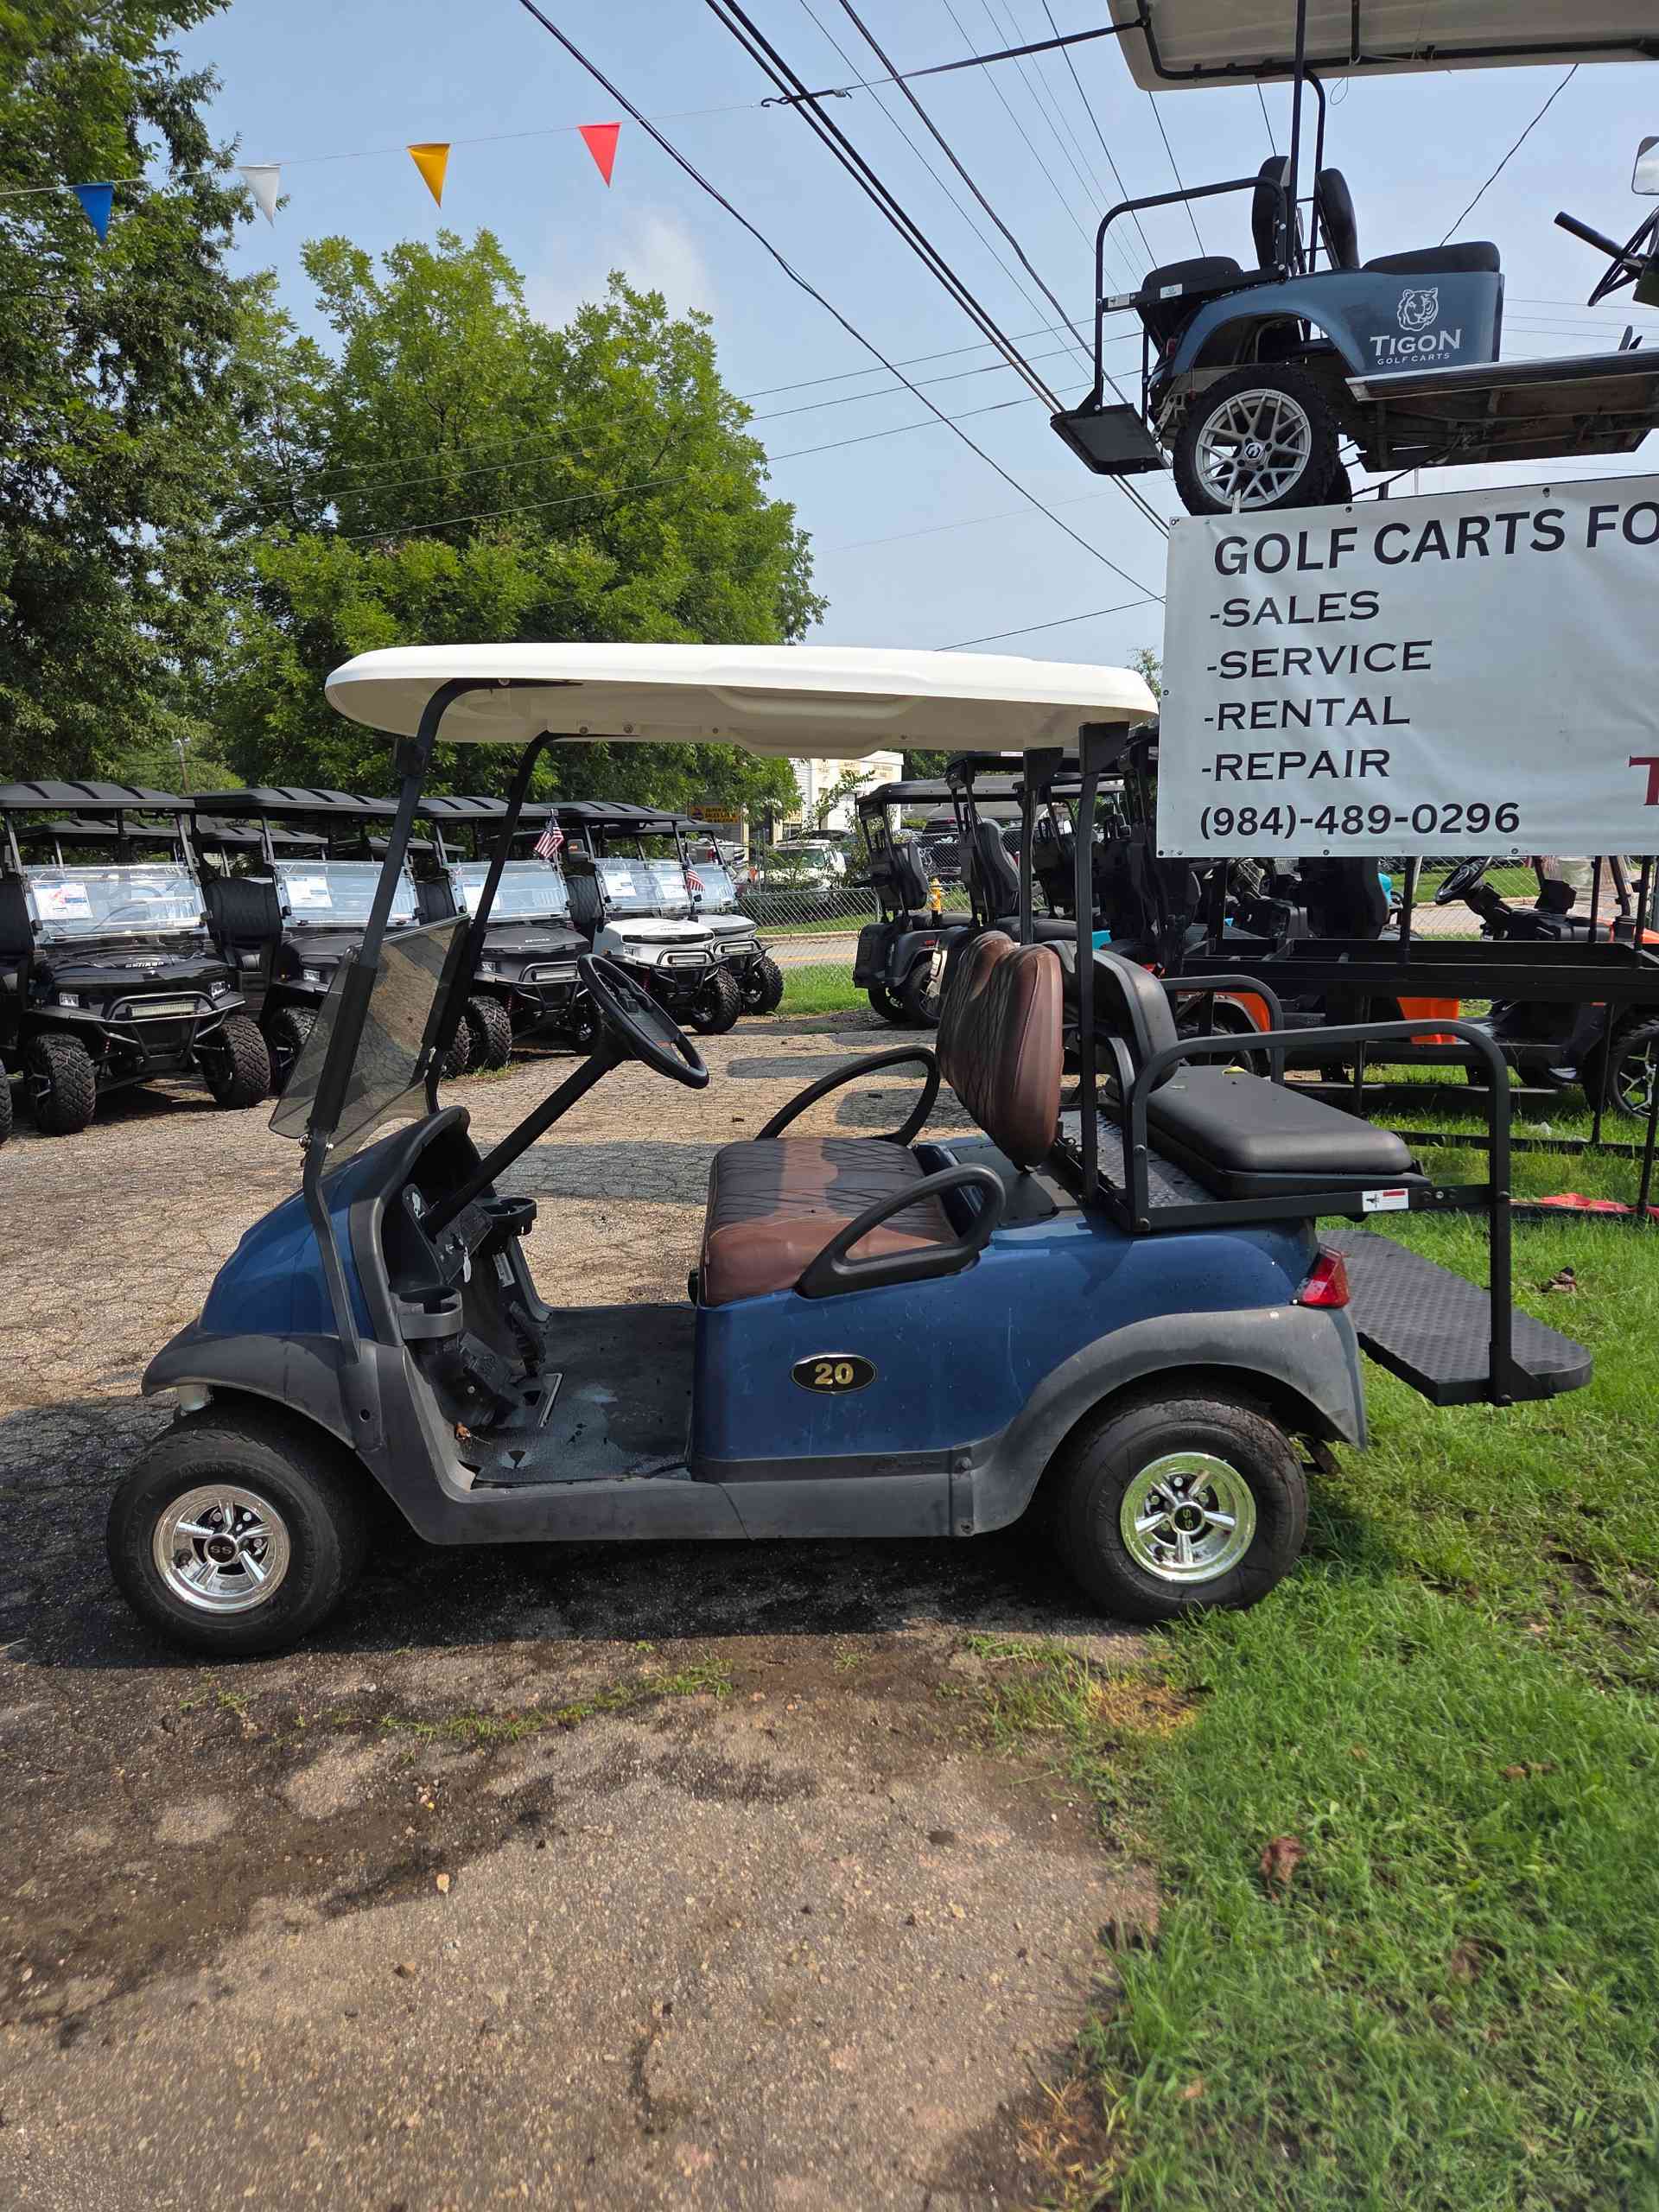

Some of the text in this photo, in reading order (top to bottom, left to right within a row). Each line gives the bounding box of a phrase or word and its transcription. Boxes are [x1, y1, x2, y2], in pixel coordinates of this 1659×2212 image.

[1370, 328, 1461, 356] TIGON
[1376, 353, 1452, 365] GOLF CARTS
[1214, 527, 1358, 576] GOLF
[1374, 508, 1566, 565] CARTS
[1210, 590, 1380, 627] -SALES
[1206, 639, 1433, 680] -SERVICE
[1204, 696, 1411, 731] -RENTAL
[1201, 748, 1390, 782] -REPAIR
[1200, 802, 1520, 840] (984)-489-0296
[814, 1362, 855, 1385] 20
